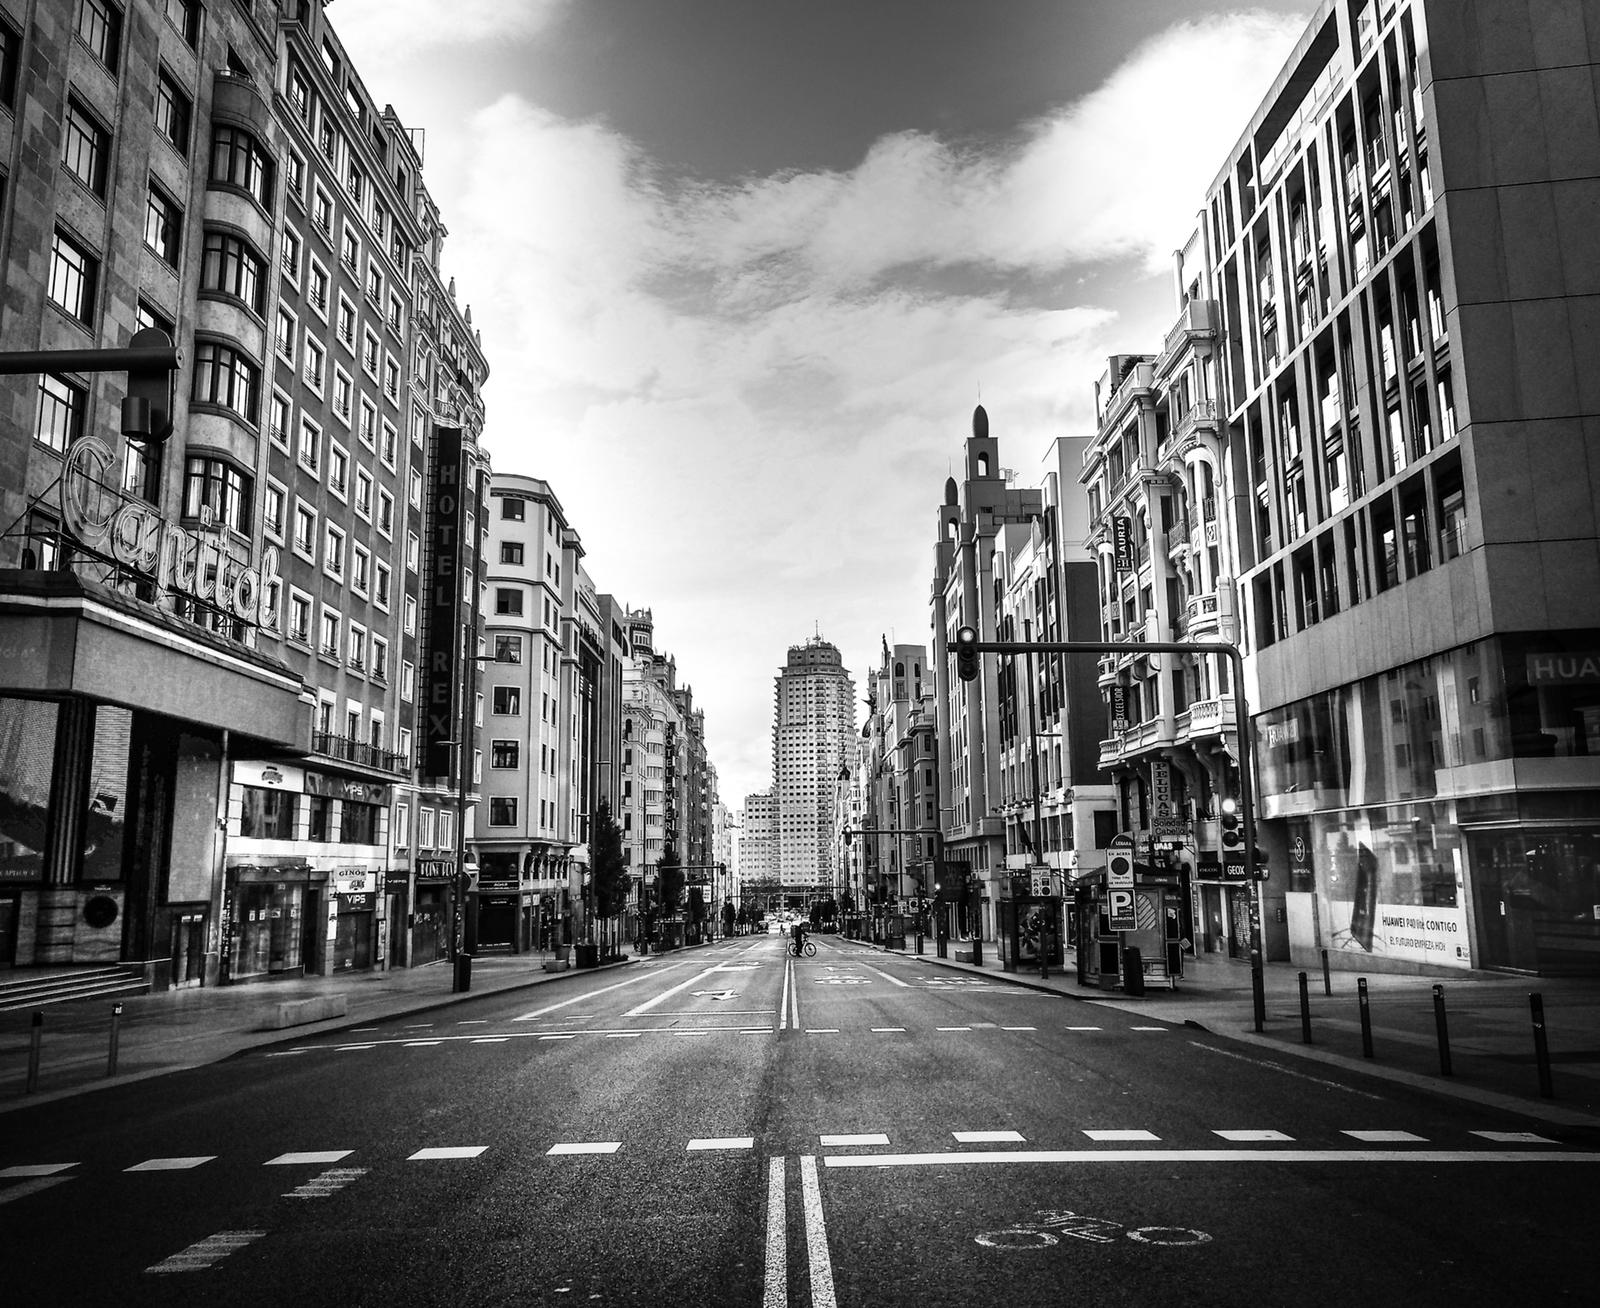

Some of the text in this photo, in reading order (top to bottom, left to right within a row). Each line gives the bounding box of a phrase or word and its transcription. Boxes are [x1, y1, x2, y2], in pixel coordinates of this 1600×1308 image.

[1117, 518, 1127, 558] LAURIA
[429, 464, 456, 736] HOTEL REX
[1535, 657, 1600, 679] HUA
[1114, 687, 1125, 720] EXCELSIOR
[665, 728, 673, 777] HOTEL
[343, 781, 363, 796] VIPS
[1155, 763, 1170, 817] PELUCAS
[1227, 865, 1246, 876] GEOX
[346, 894, 366, 904] VIPS
[1110, 891, 1131, 916] P
[1382, 916, 1405, 927] HUAWEI
[1426, 921, 1457, 932] CONTIGO
